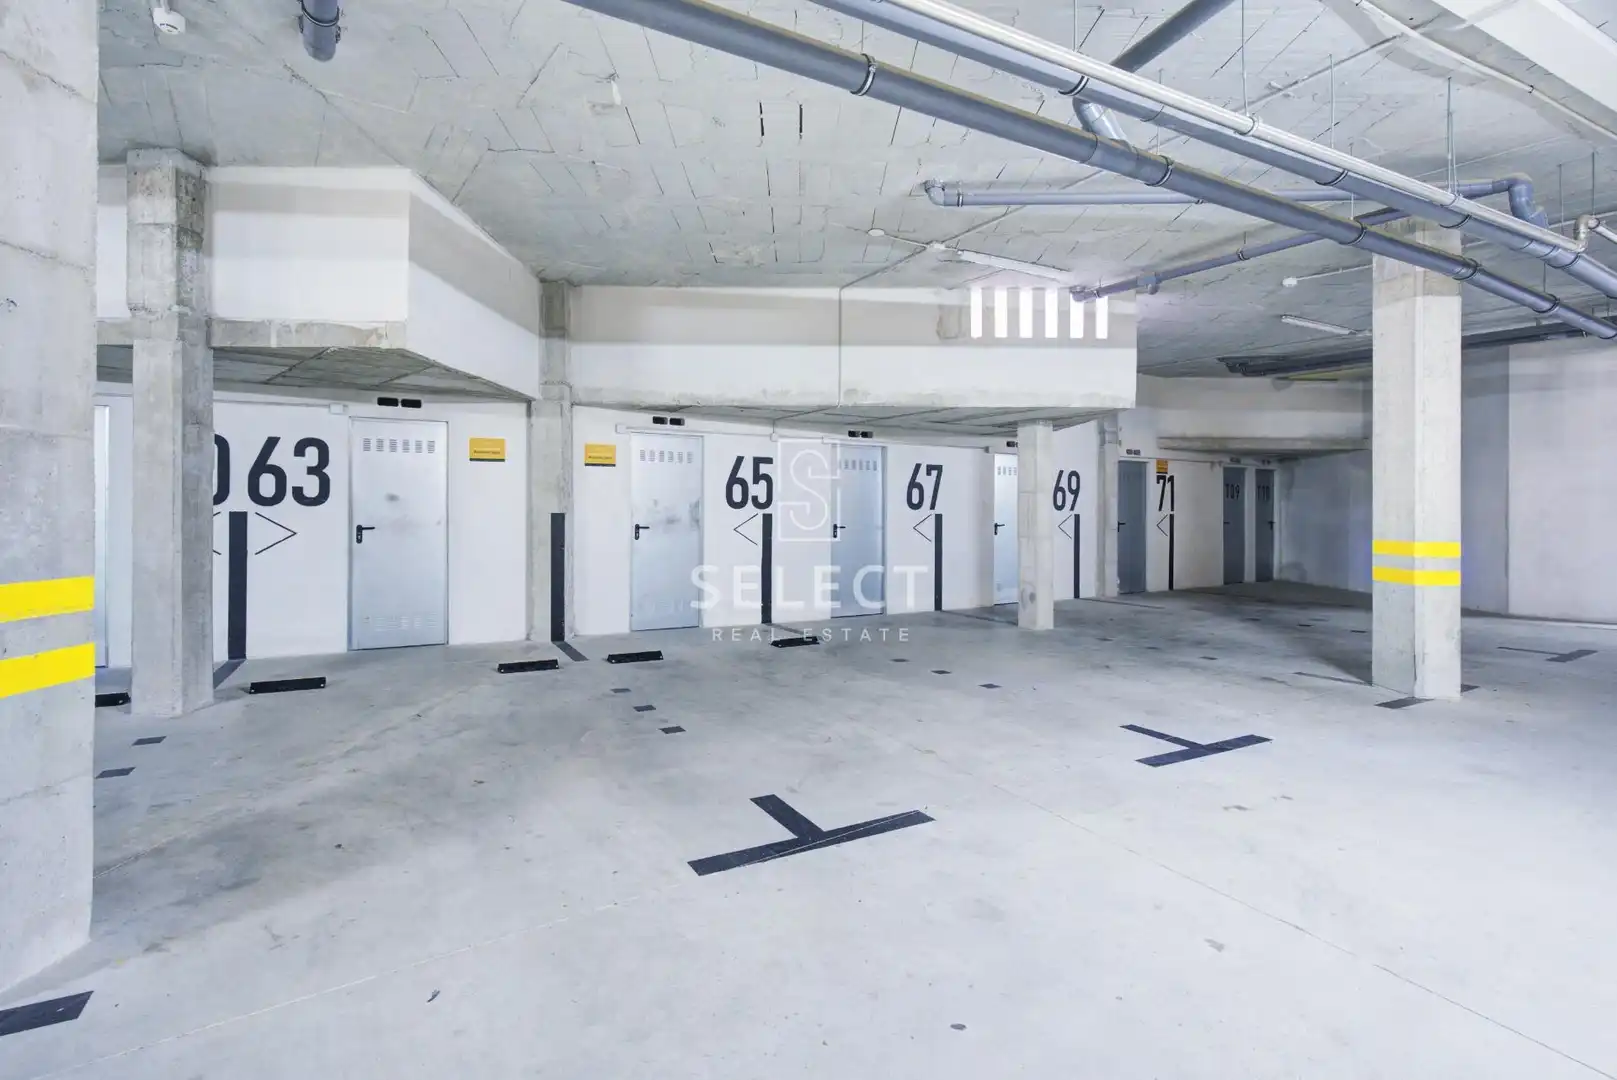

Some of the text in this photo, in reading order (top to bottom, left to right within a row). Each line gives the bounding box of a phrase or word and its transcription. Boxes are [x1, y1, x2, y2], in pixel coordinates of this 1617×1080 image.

[247, 436, 331, 507] 63
[725, 456, 774, 510] 65
[906, 463, 943, 511] 67
[1053, 470, 1080, 511] 69
[1156, 475, 1174, 511] 71
